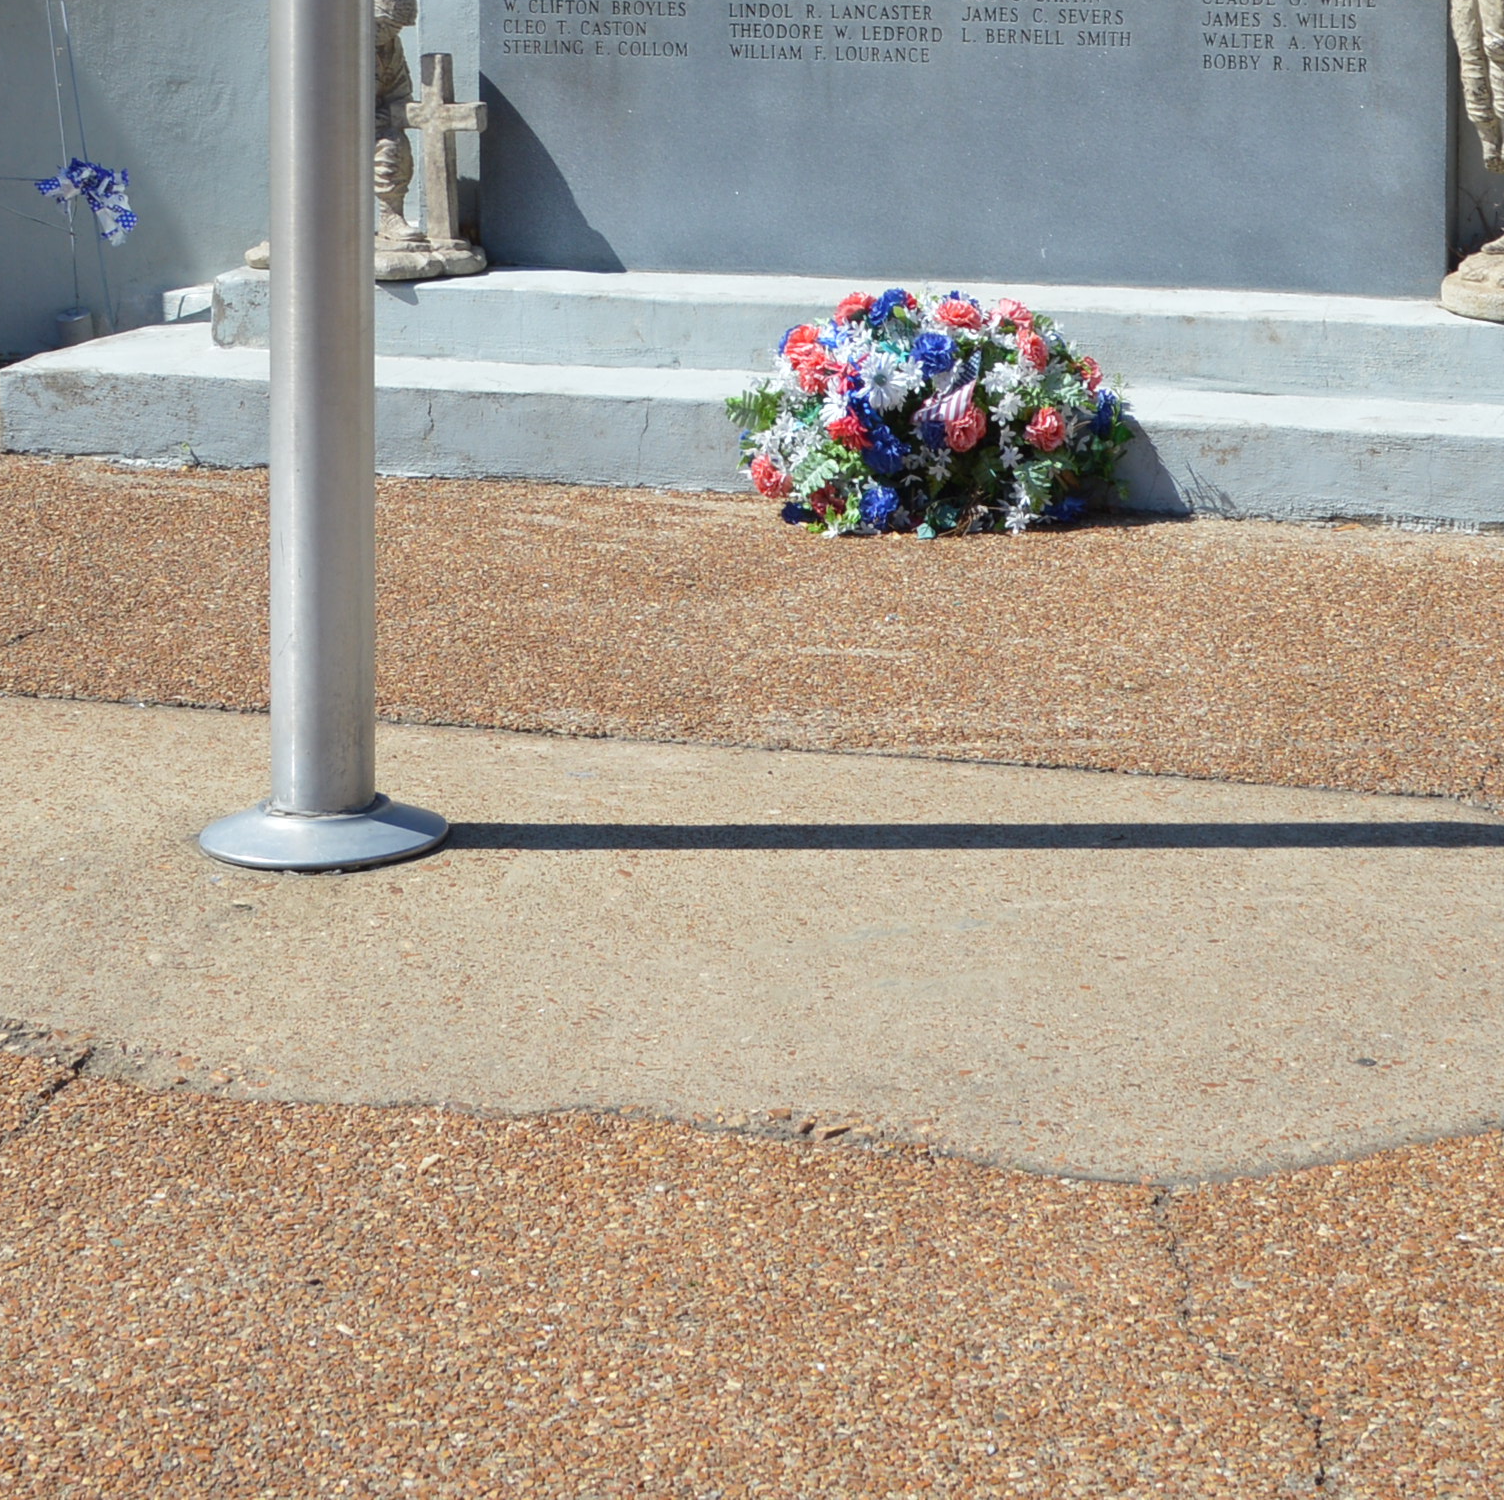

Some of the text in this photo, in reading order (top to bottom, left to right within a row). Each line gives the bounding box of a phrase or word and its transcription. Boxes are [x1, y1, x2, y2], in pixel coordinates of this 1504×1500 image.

[504, 0, 686, 16] W. CLIFTON BROYLES
[962, 28, 1130, 46] L. BERNELL SMITH
[504, 40, 687, 56] STERLING E. COLLOM
[729, 44, 929, 63] WILLIAM F. LOURANCE
[1203, 54, 1367, 72] BOBBY R. RISNER
